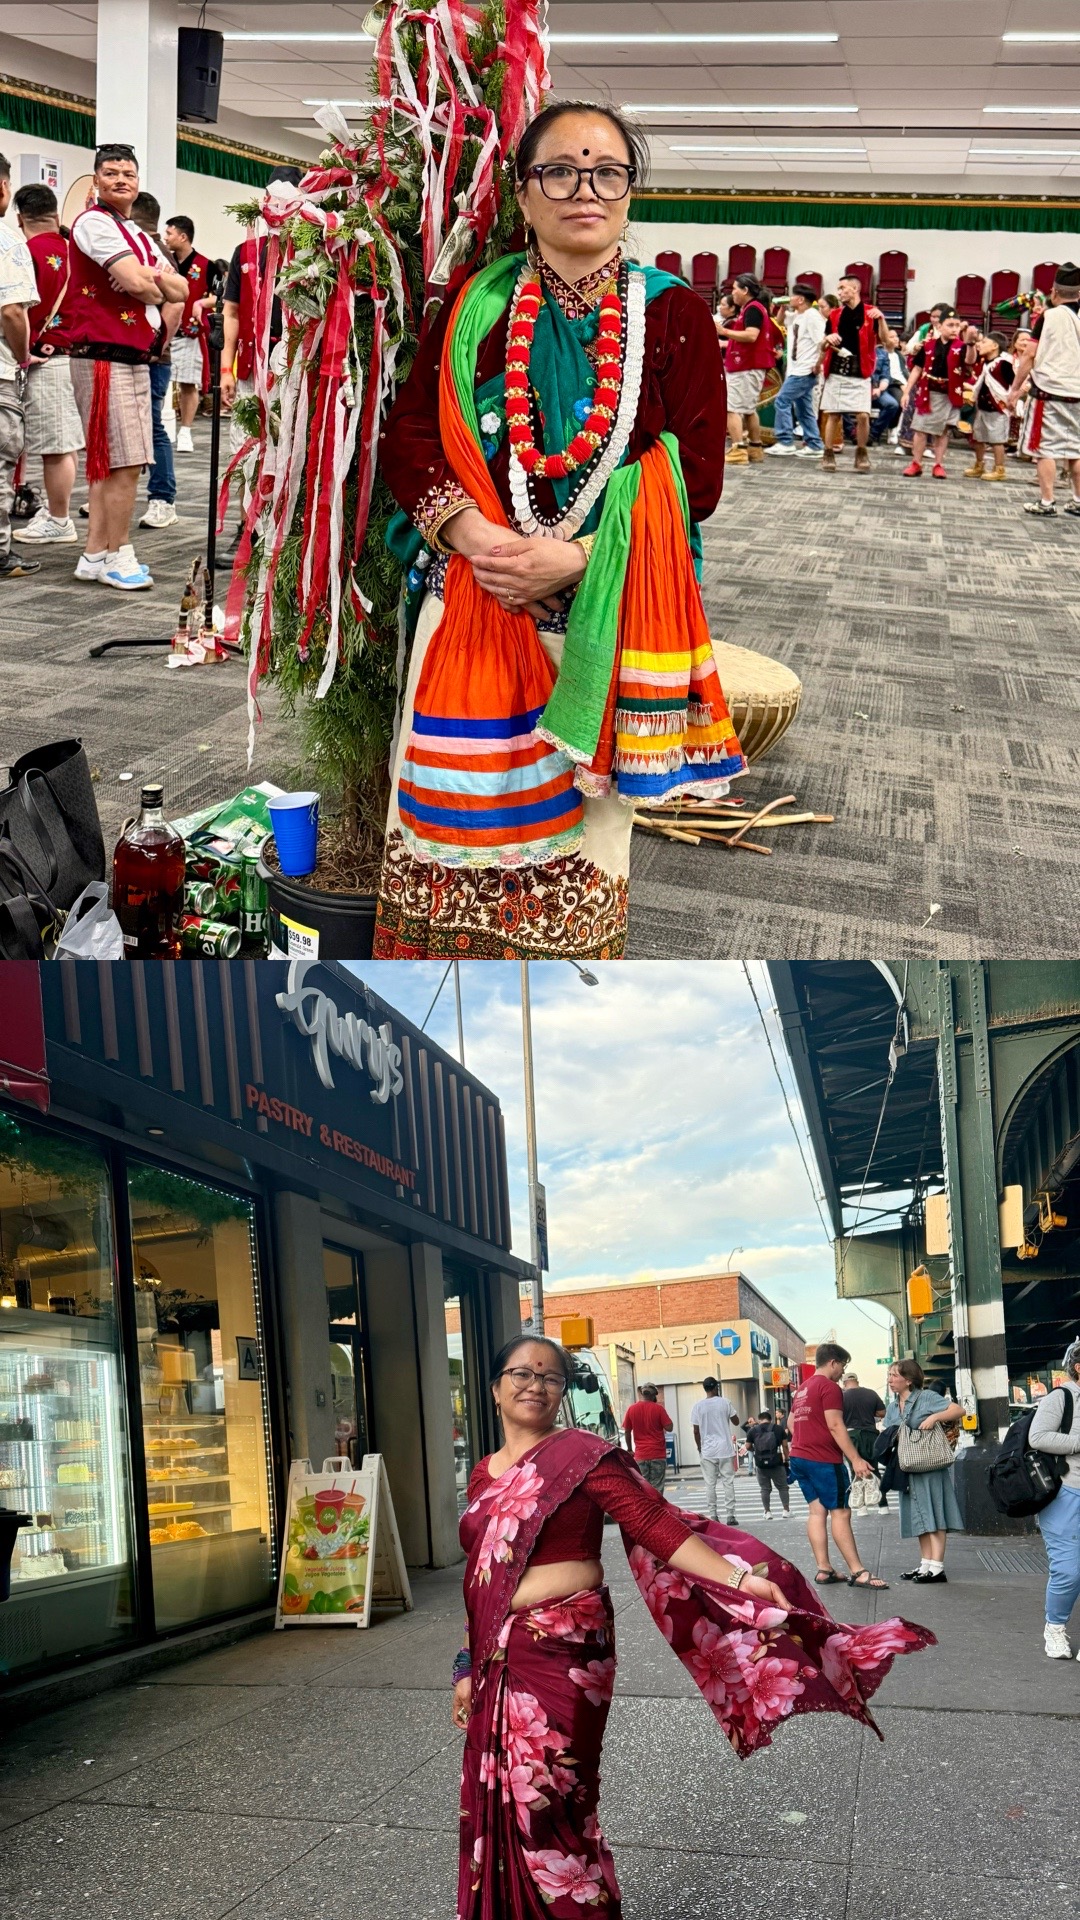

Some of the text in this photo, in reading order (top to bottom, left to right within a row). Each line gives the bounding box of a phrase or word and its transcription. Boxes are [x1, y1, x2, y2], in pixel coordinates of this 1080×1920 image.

[289, 930, 312, 947] $59.98
[245, 1084, 416, 1190] PASTRY & RESTAURANT
[243, 1347, 256, 1369] A
[620, 1334, 708, 1360] HASE
